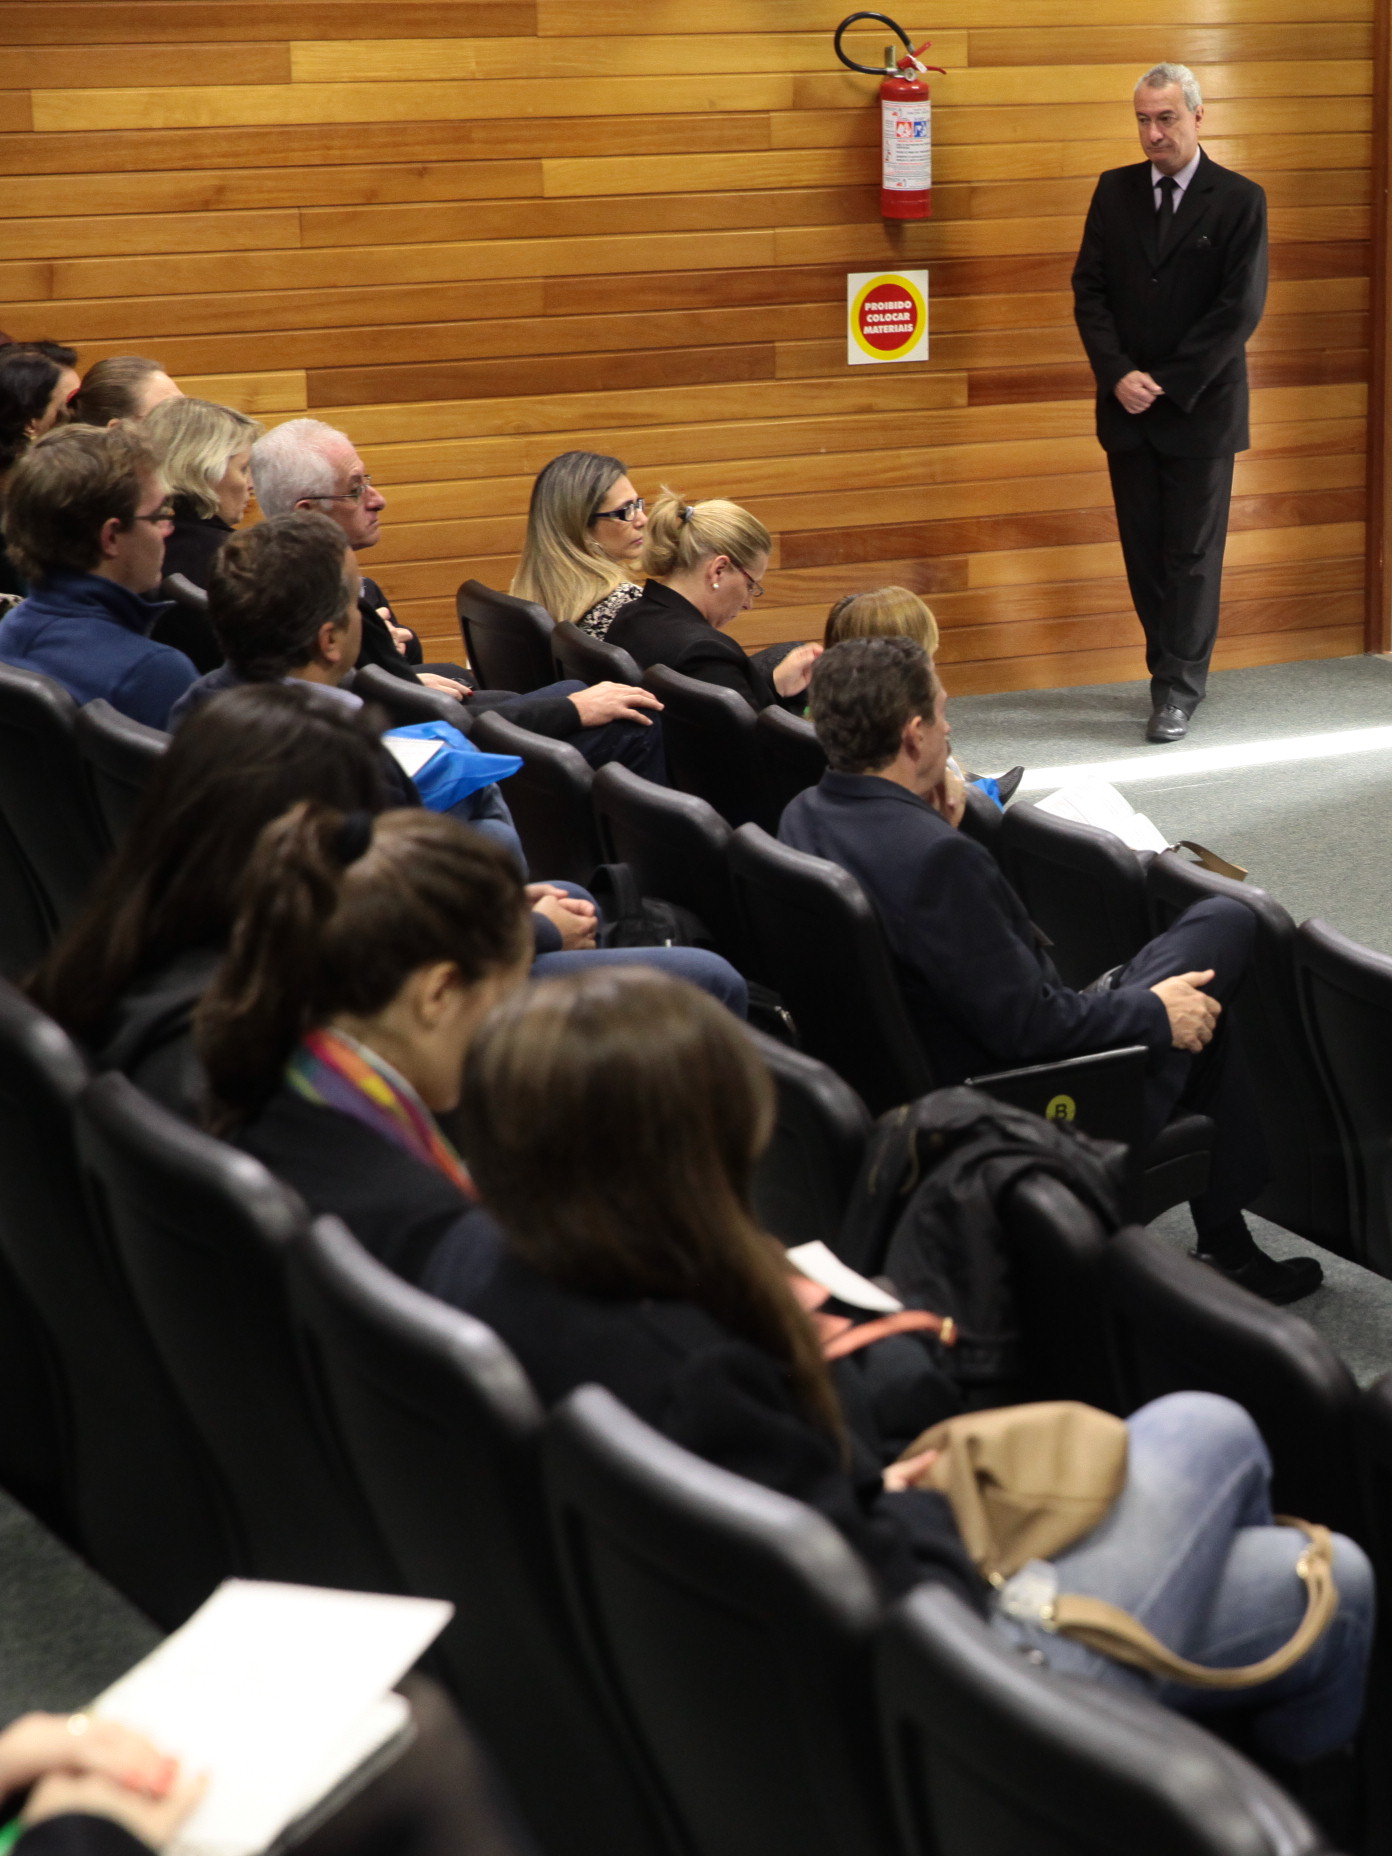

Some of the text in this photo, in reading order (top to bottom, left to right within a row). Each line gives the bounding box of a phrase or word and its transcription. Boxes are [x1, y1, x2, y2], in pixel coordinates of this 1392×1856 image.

[864, 301, 912, 311] PROIBIDO
[866, 312, 911, 322] COLOCAR
[863, 324, 914, 334] MATERIAIS
[1055, 1103, 1067, 1119] B
